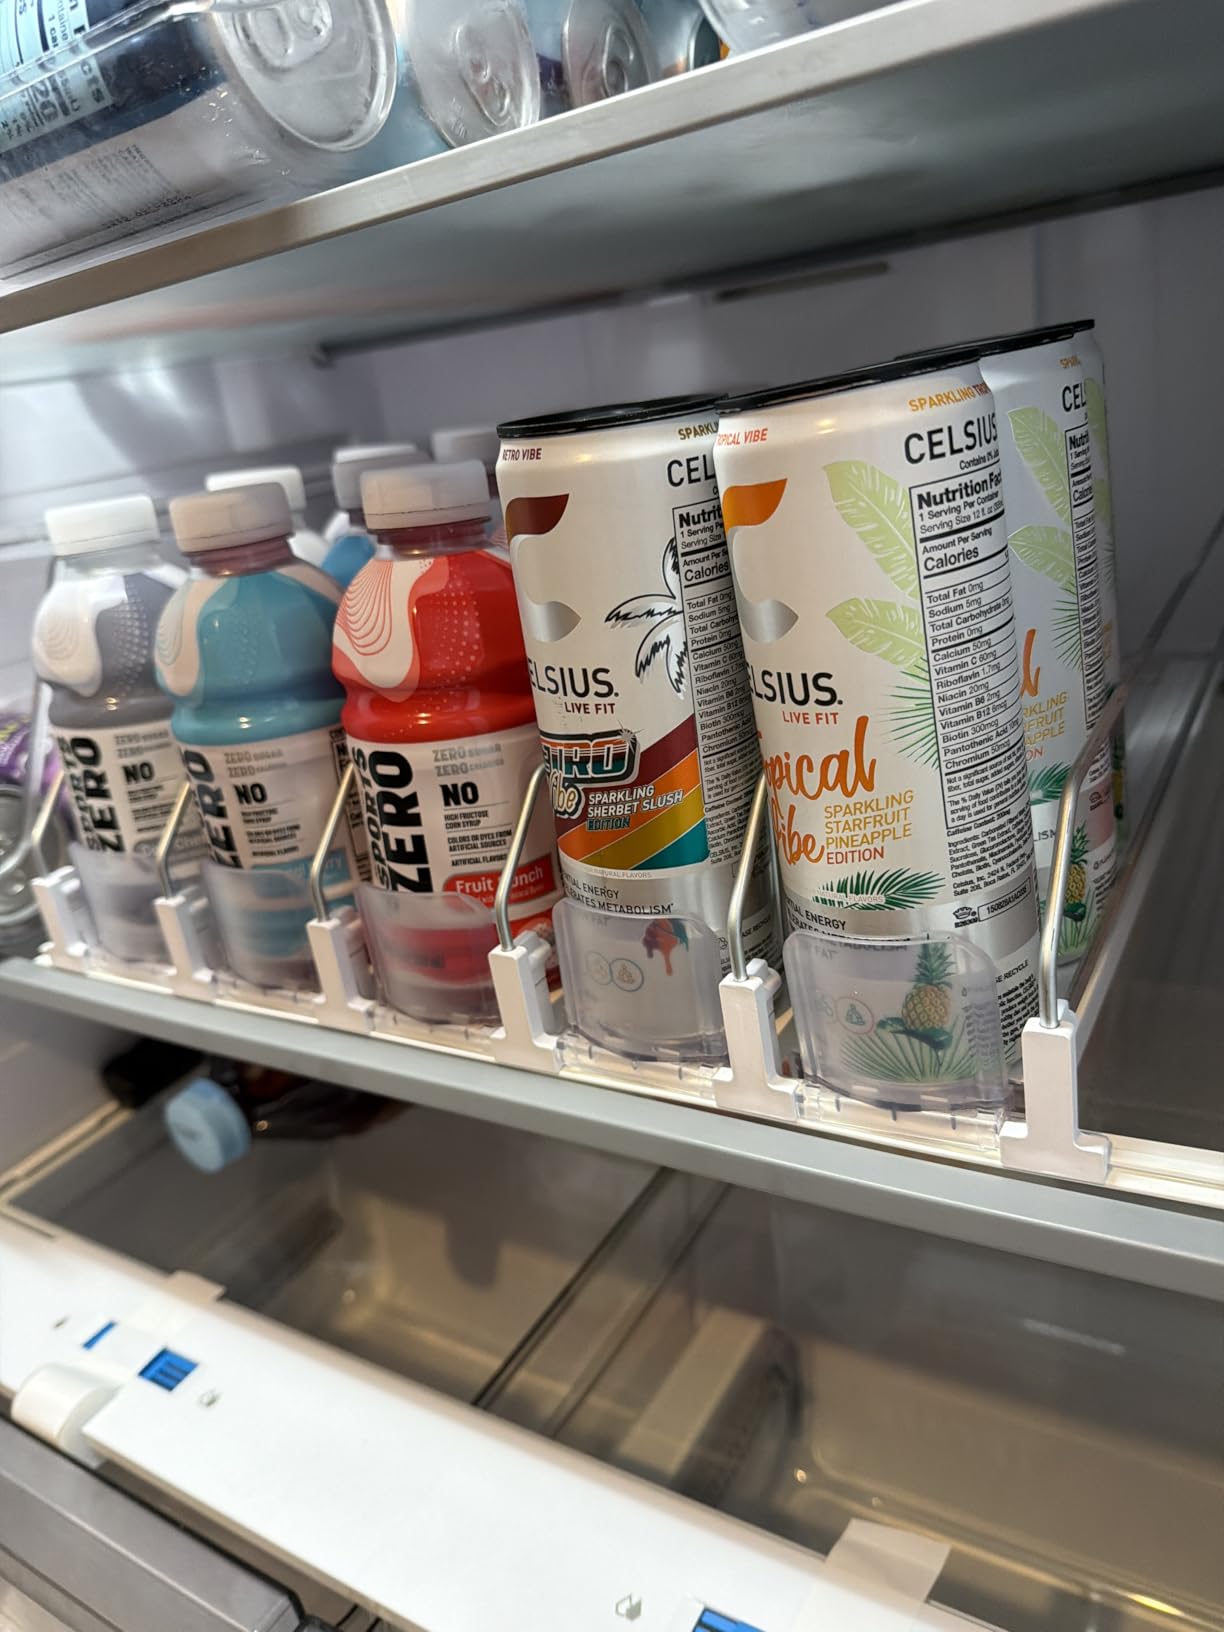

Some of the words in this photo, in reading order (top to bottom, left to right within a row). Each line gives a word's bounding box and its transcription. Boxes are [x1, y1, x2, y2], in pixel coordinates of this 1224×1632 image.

[908, 386, 976, 412] SPARKLING
[678, 421, 718, 441] SPARKLI
[744, 428, 768, 444] VIBE
[904, 412, 998, 465] CELSIUS
[521, 448, 543, 461] VIBE
[916, 478, 988, 510] Nutrition
[678, 505, 723, 529] Nutrit
[927, 504, 961, 521] Serving
[963, 498, 976, 511] Per
[687, 524, 714, 538] Serving
[919, 518, 953, 535] Serving
[954, 513, 971, 527] Size
[973, 510, 981, 520] 12
[681, 537, 708, 551] Serving
[708, 533, 722, 543] Size
[922, 538, 957, 555] Amount
[957, 535, 970, 547] Per
[970, 526, 993, 541] Serving
[682, 553, 711, 568] Amount
[711, 551, 722, 560] Per
[923, 546, 980, 572] Calories
[684, 560, 729, 583] Calories
[687, 600, 706, 611] Total
[707, 596, 719, 606] Fat
[926, 591, 951, 605] Total
[952, 587, 967, 599] Fat
[968, 580, 984, 594] 0mg
[688, 608, 717, 623] Sodium
[928, 602, 964, 619] Sodium
[965, 596, 982, 609] 5mg
[929, 619, 953, 633] Total
[955, 602, 1002, 626] Carbohydrate
[690, 623, 709, 635] Total
[931, 631, 965, 647] Protein
[966, 625, 983, 639] 0mg
[691, 633, 717, 648] Protein
[933, 645, 971, 663] Calcium
[972, 636, 992, 651] 50mg
[693, 646, 722, 661] Calcium
[934, 660, 969, 677] Vitamin
[970, 655, 977, 666] C
[978, 648, 997, 663] 60mg
[693, 659, 721, 673] Vitamin
[695, 668, 730, 685] Riboflavin
[936, 671, 980, 691] Riboflavin
[981, 660, 1001, 676] 1.7mg
[696, 684, 720, 697] Niacin
[750, 668, 844, 708] LSIUS.
[937, 689, 967, 705] Niacin
[968, 680, 989, 696] 20mg
[564, 702, 591, 715] LIVE
[595, 702, 616, 715] FIT
[697, 694, 725, 708] Vitamin
[939, 701, 973, 717] Vitamin
[986, 689, 1001, 703] 2mg
[698, 706, 726, 720] Vitamin
[782, 711, 811, 725] LIVE
[815, 712, 839, 725] FIT
[940, 714, 975, 731] Vitamin
[976, 707, 991, 721] B12
[700, 718, 721, 731] Biotin
[942, 730, 969, 744] Biotin
[971, 717, 999, 736] 300mcg
[1024, 720, 1065, 746] APPLE
[943, 731, 994, 757] Pantothenic
[994, 725, 1008, 738] Acid
[432, 747, 467, 763] ZERO
[945, 748, 990, 770] Chromium
[991, 739, 1011, 756] 50mcg
[122, 761, 155, 784] NO
[435, 762, 470, 778] ZERO
[70, 737, 126, 853] ZERO
[233, 782, 268, 806] NO
[439, 781, 480, 807] NO
[587, 801, 640, 818] SHERBET
[641, 790, 684, 812] SLUSH
[588, 785, 655, 805] SPARKLING
[824, 789, 914, 820] SPARKLING
[367, 749, 434, 893] ZERO
[444, 812, 459, 822] HIGH
[459, 809, 489, 820] FRUCTOSE
[445, 821, 462, 831] CORN
[462, 818, 482, 829] SYRUP
[587, 816, 630, 832] EDITION
[824, 806, 911, 835] STARFRUIT
[447, 834, 471, 845] COLORS
[448, 841, 481, 854] ARTIFICIAL
[825, 823, 913, 850] PINEAPPLE
[451, 855, 482, 868] ARTIFICIAL
[826, 846, 885, 866] EDITION
[456, 877, 494, 893] Fruit
[582, 882, 620, 900] ENERGY
[805, 911, 846, 931] ENERGY
